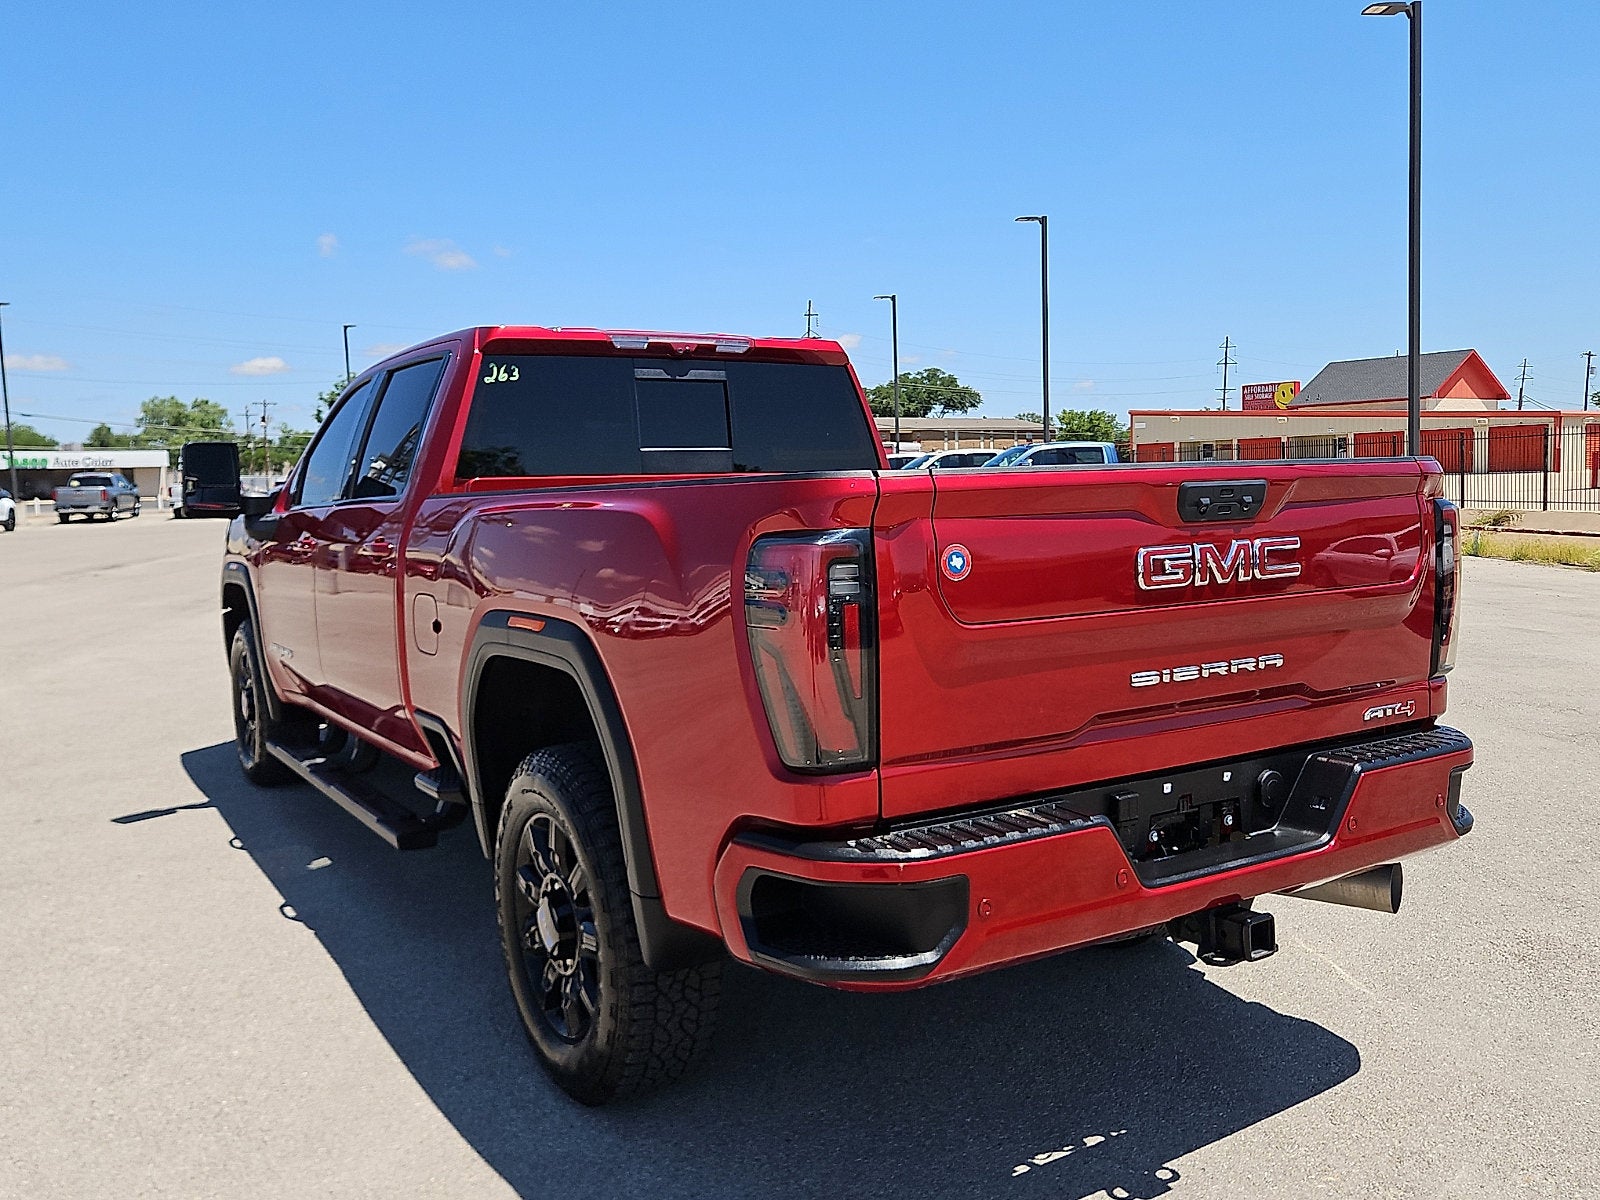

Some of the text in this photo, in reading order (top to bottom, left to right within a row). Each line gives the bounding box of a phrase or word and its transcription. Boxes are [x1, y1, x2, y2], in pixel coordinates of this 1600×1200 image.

[483, 362, 519, 384] 263
[1244, 384, 1279, 394] AFFORDABLE
[1137, 536, 1302, 591] GMC
[1130, 653, 1285, 688] SIERRA
[1362, 700, 1416, 722] AT4
